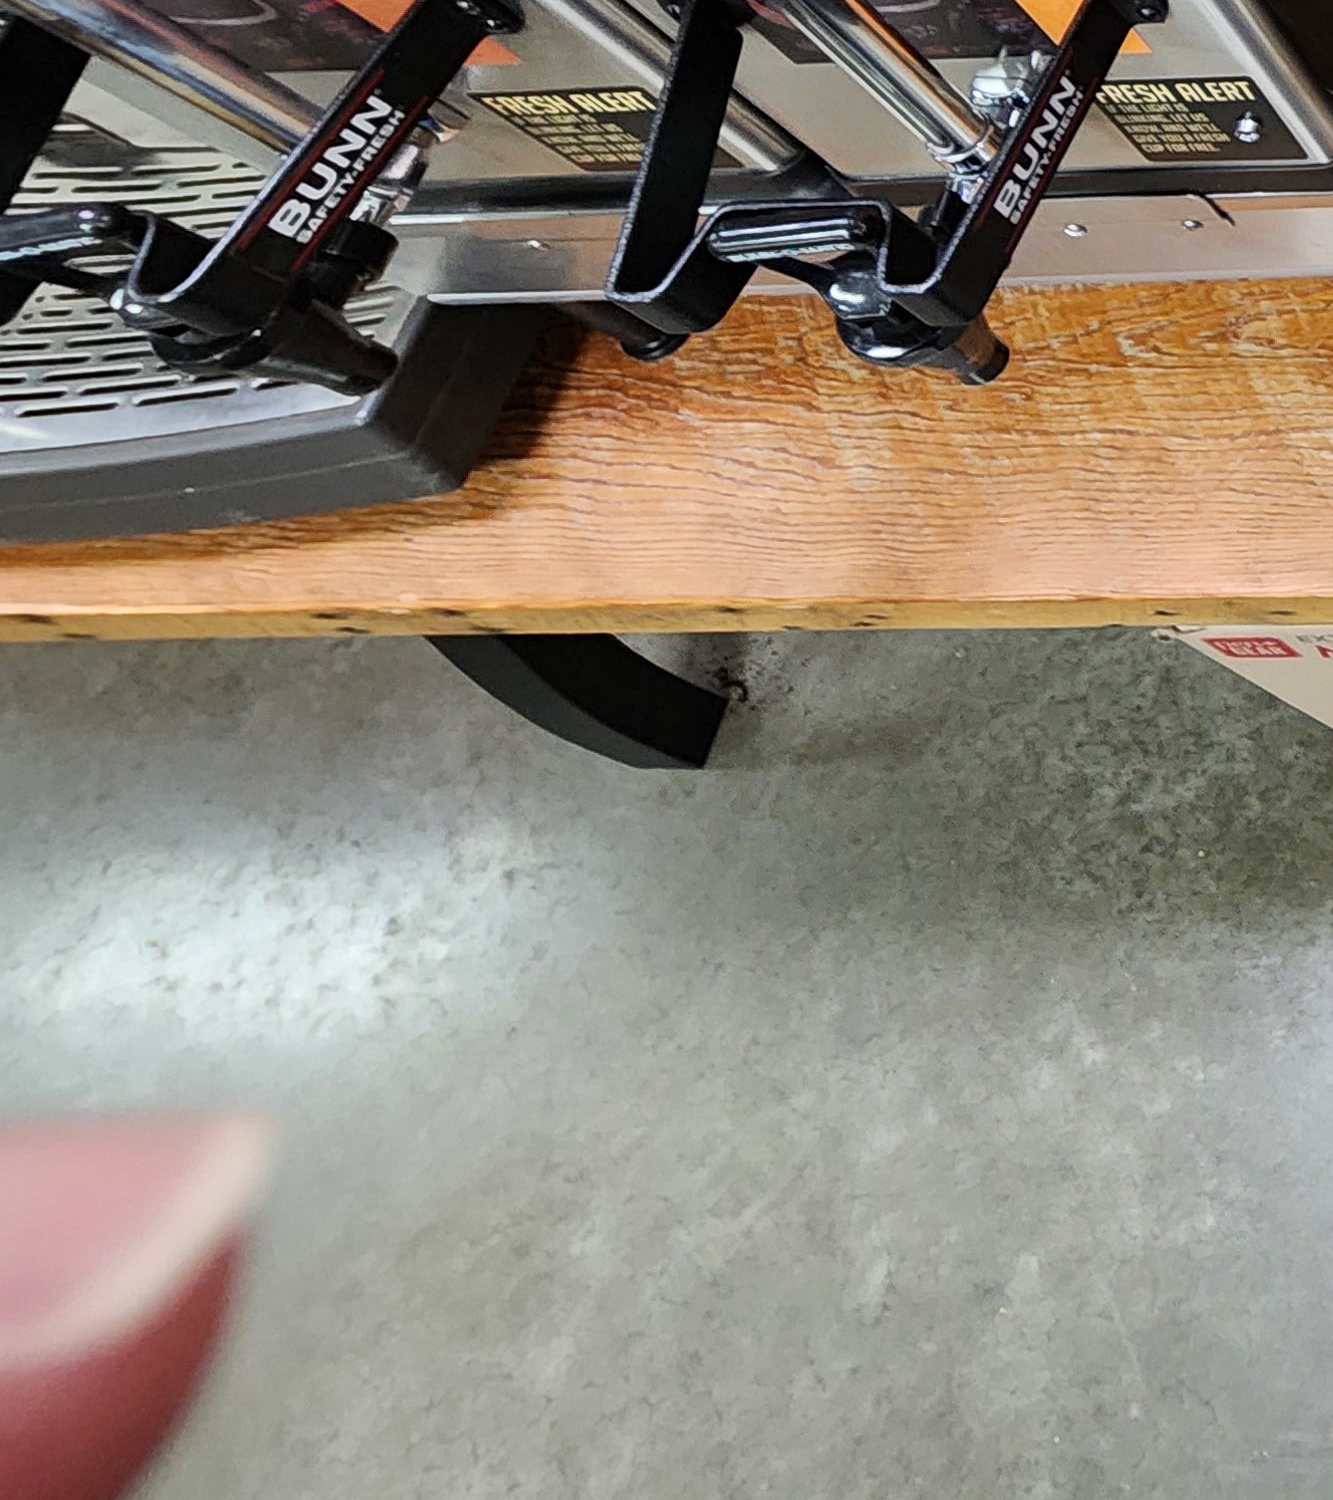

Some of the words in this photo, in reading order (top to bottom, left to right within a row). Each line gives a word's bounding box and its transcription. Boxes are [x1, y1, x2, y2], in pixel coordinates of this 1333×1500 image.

[481, 93, 580, 117] FRESH
[568, 90, 658, 113] ALERT
[993, 75, 1077, 218] BUNN
[1010, 90, 1084, 225] SAFETY-FRESH
[1096, 83, 1177, 104] FRESH
[1174, 80, 1257, 102] ALERT
[267, 93, 394, 238] BUNN
[296, 108, 406, 244] SAFETY-FRESH
